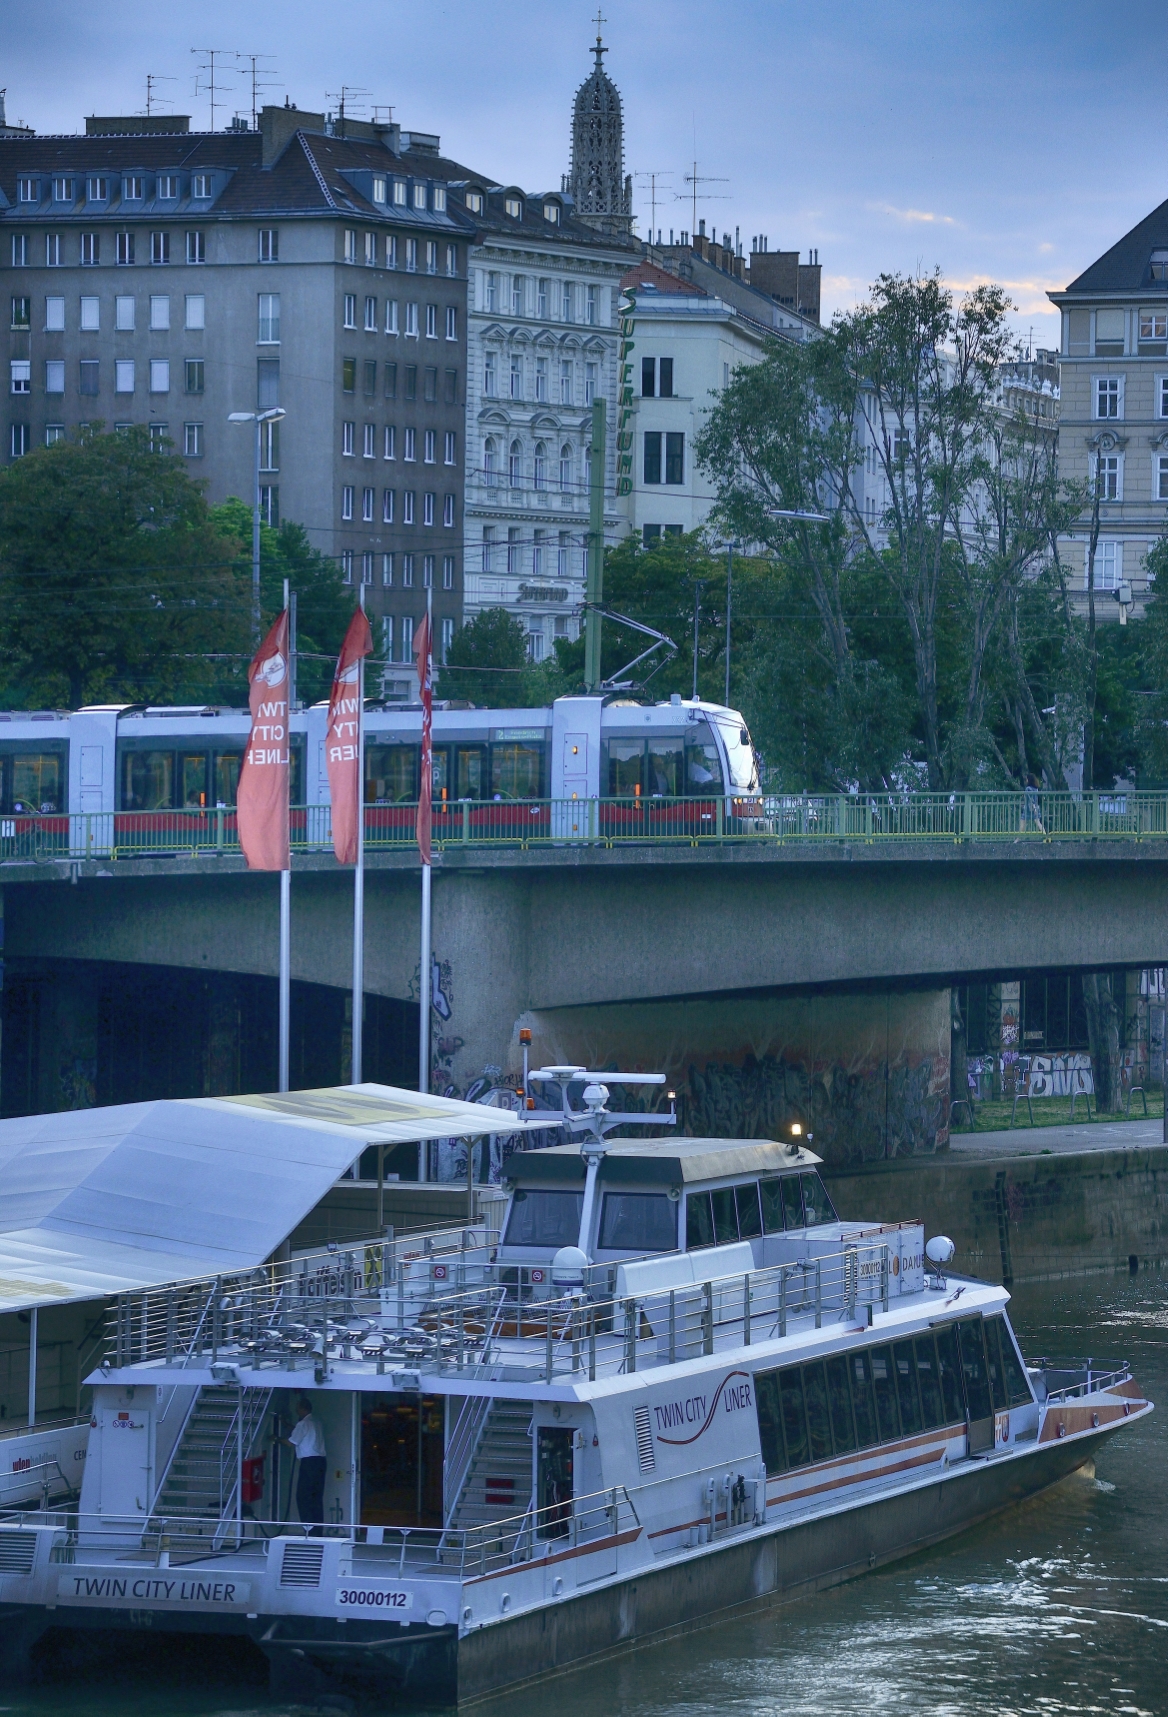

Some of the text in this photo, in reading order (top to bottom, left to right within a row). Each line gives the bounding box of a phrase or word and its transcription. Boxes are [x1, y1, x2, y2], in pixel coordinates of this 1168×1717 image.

[616, 286, 637, 497] SUPERFUND
[654, 1384, 752, 1430] TWIN CITY LINER
[74, 1577, 236, 1602] TWIN CITY LINER
[339, 1590, 407, 1607] 30000112
